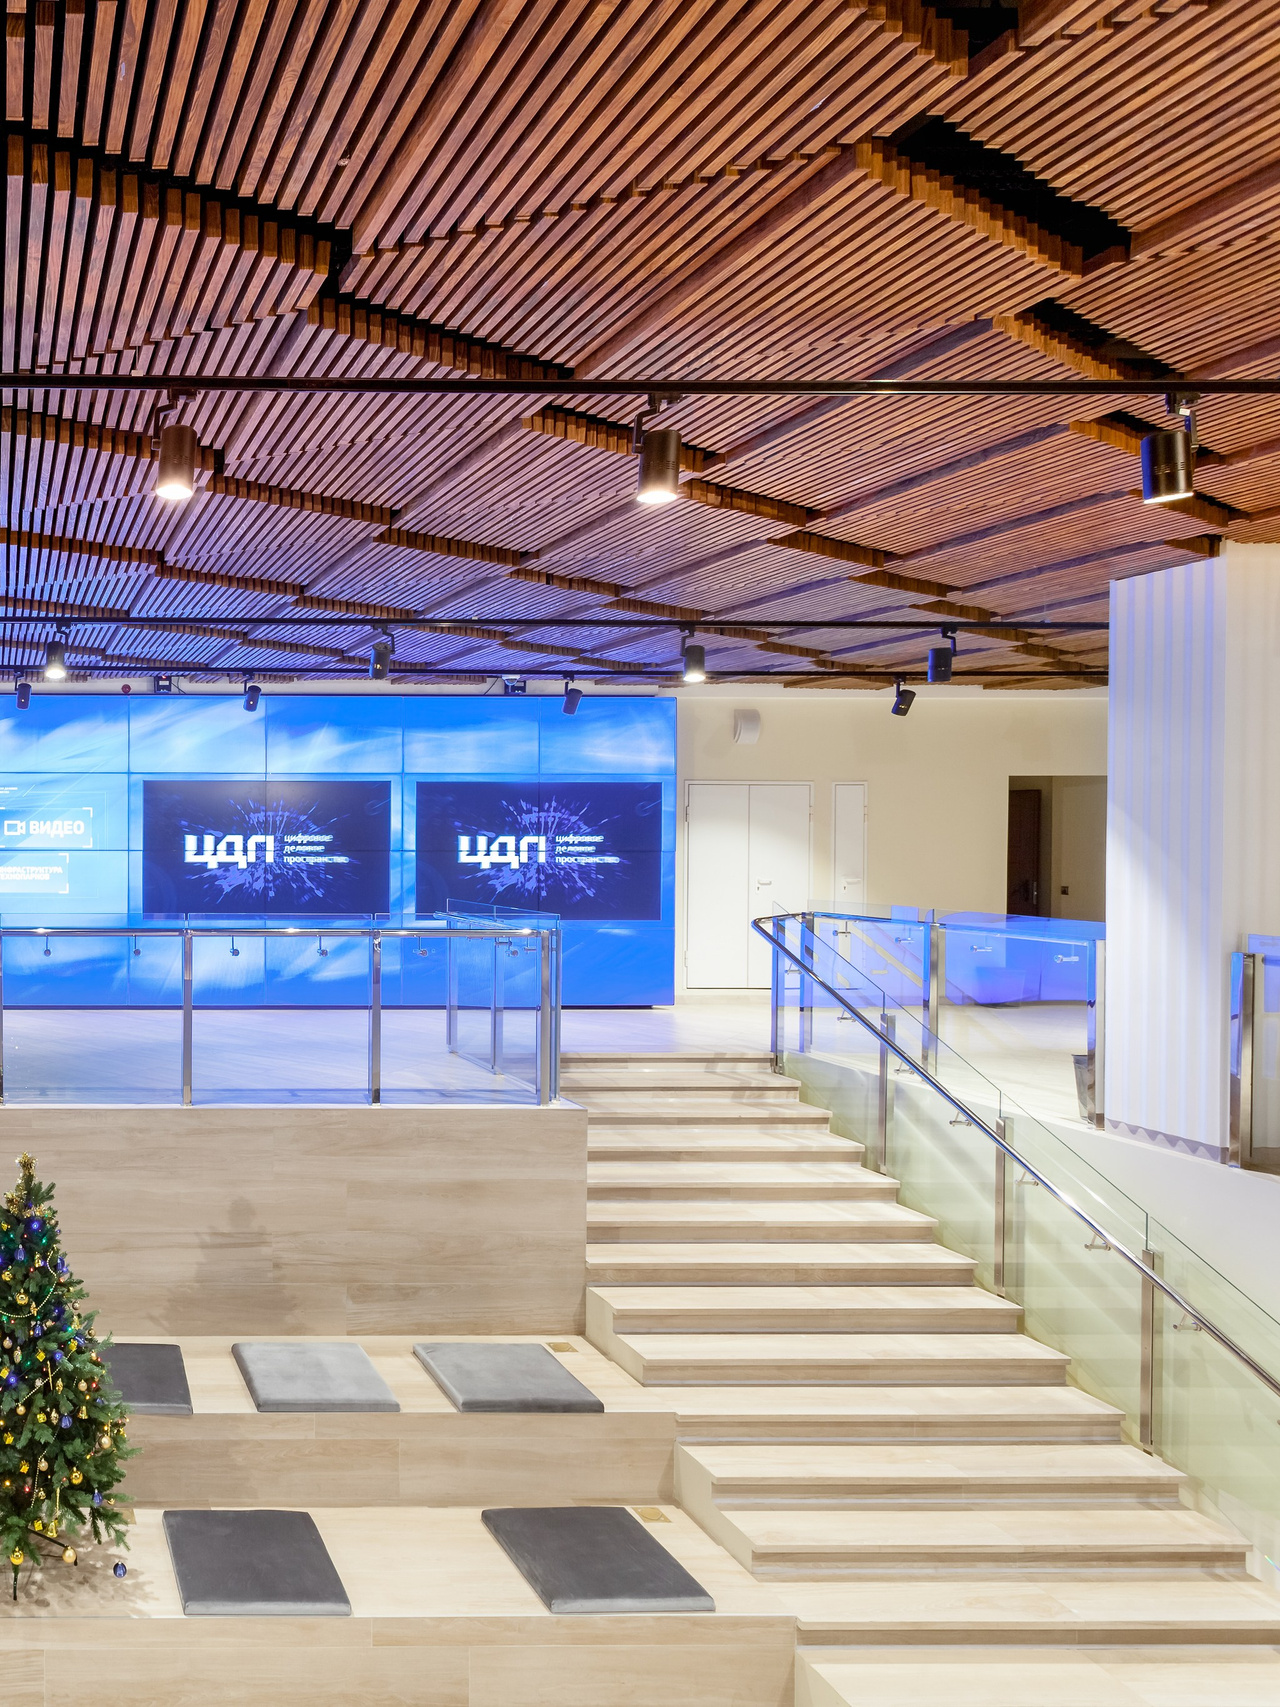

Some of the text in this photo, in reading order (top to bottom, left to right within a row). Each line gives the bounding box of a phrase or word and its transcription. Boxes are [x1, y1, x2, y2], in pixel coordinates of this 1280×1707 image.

[29, 820, 85, 837] ВИДЕО
[184, 834, 274, 869] ЦДП
[458, 835, 546, 869] ЦДП
